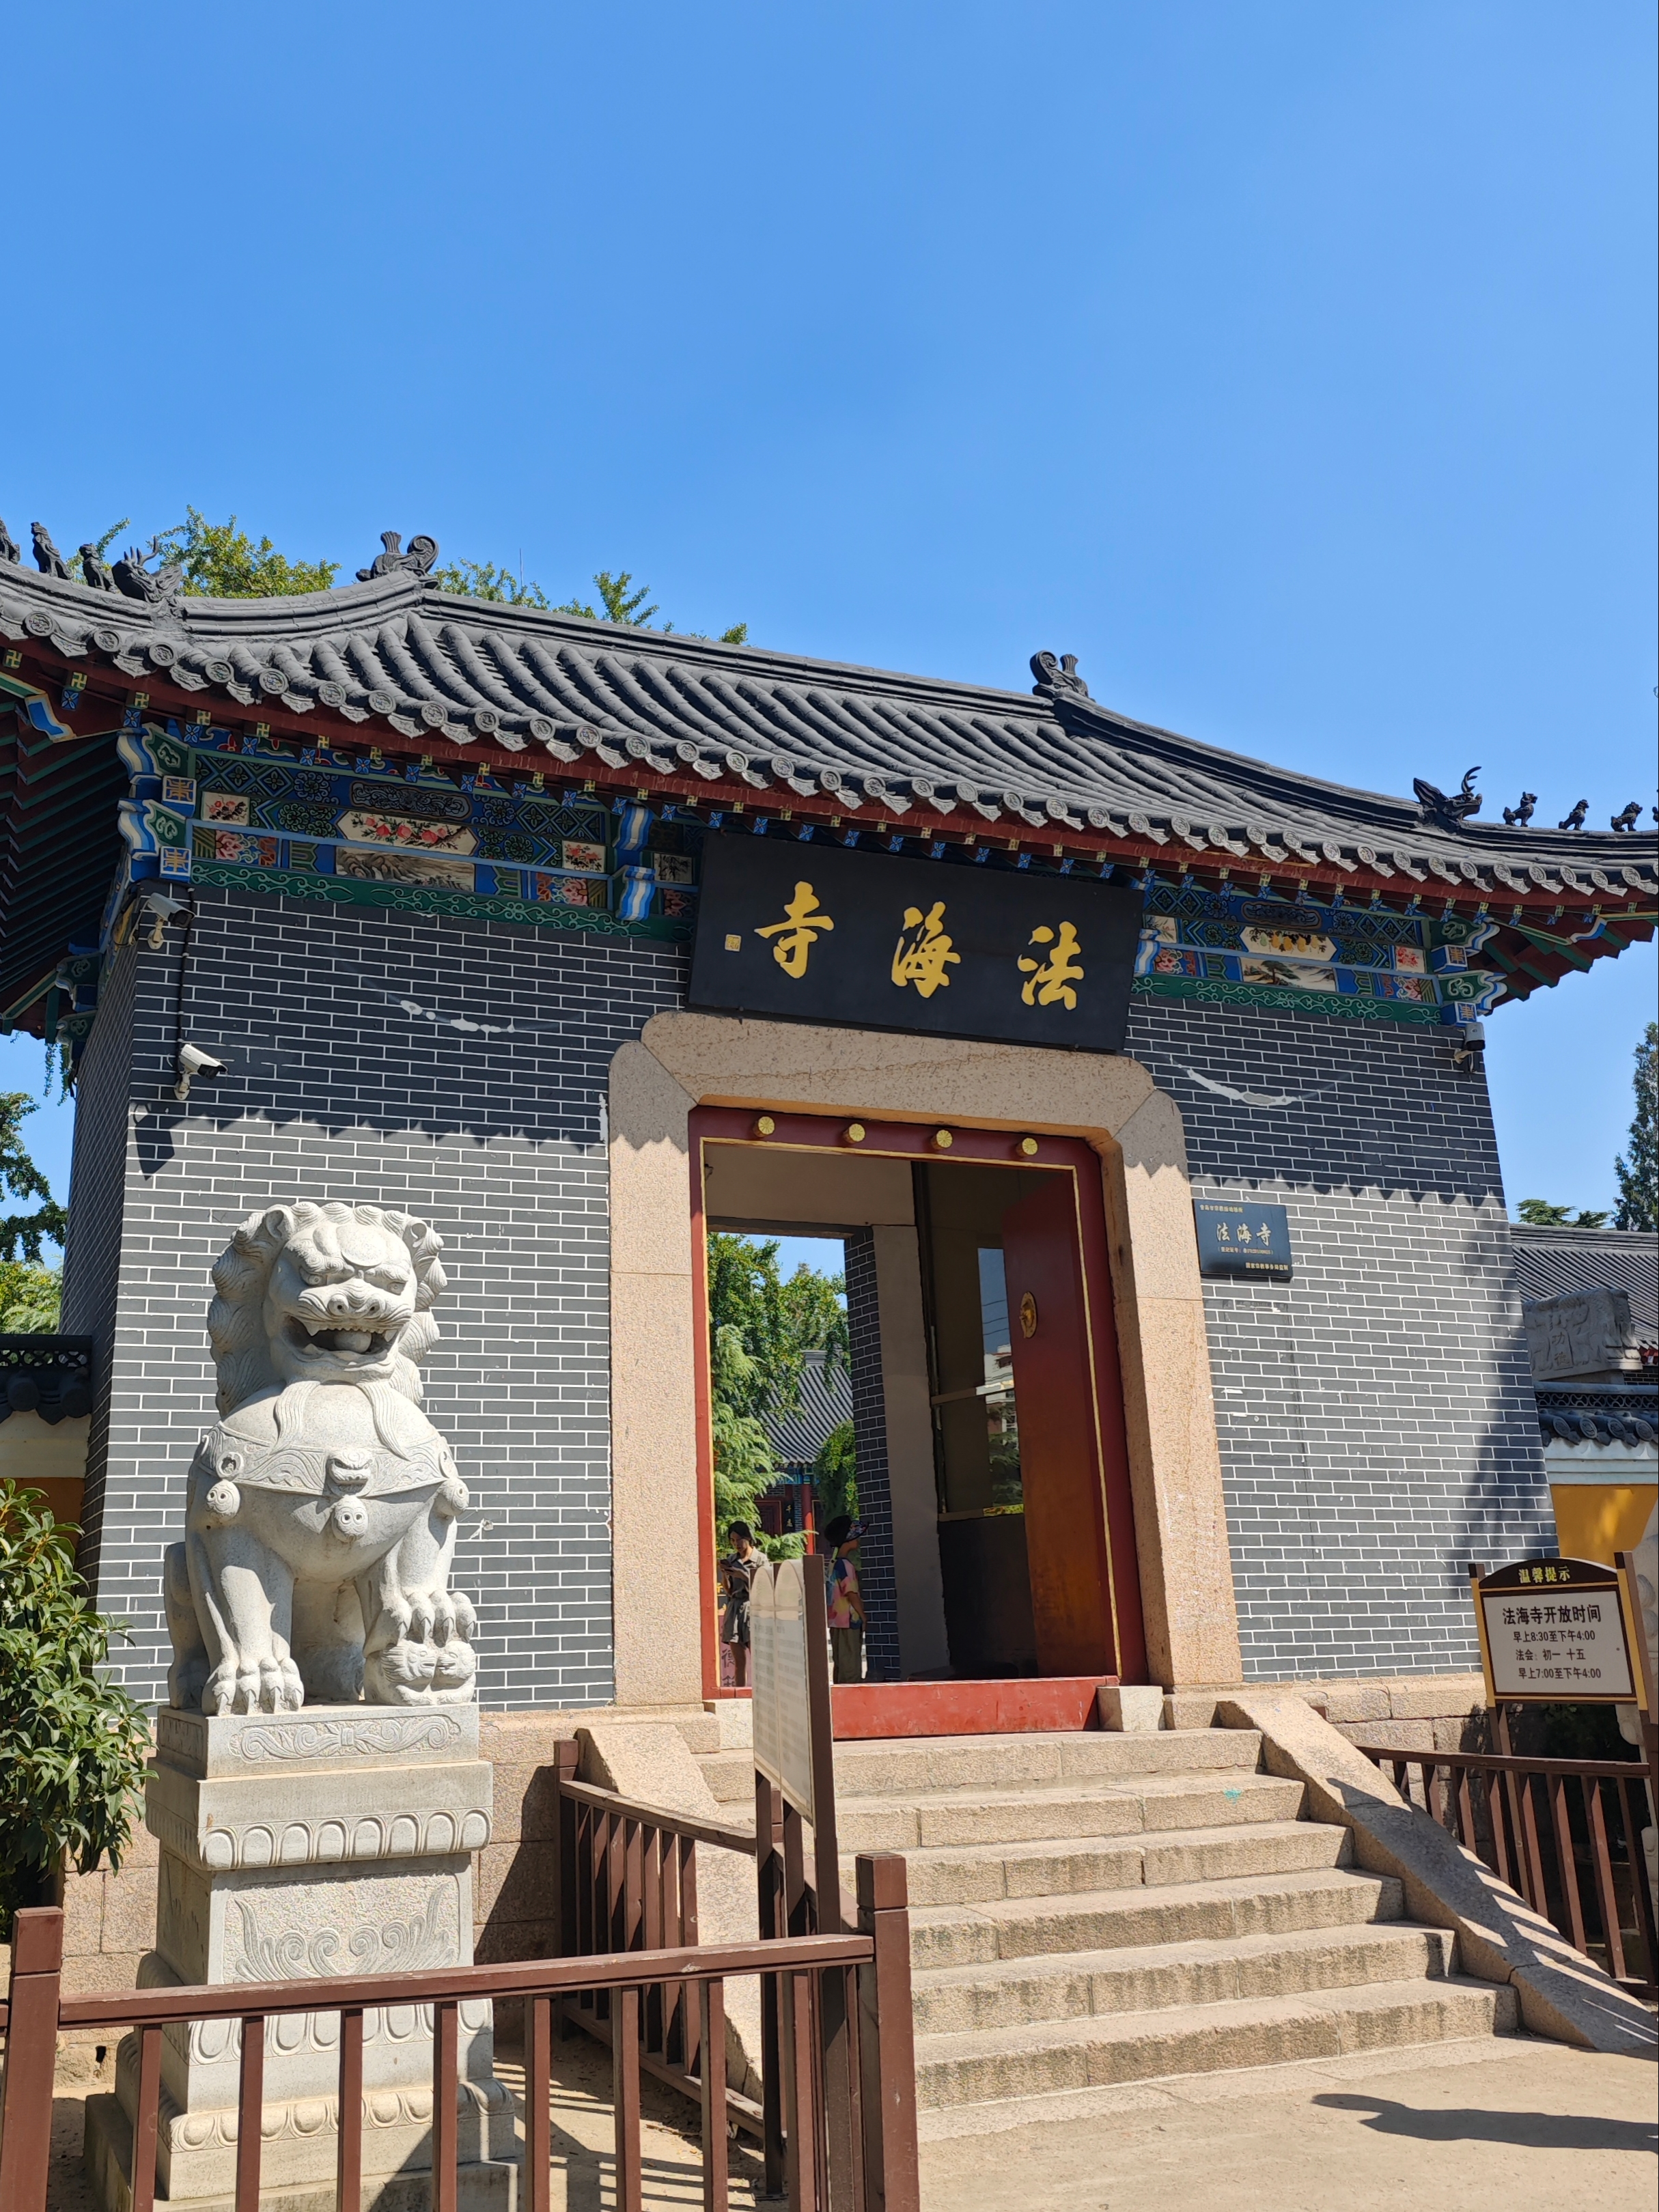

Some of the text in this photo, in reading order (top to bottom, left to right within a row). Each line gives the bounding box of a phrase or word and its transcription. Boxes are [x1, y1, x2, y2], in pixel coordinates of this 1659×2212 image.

[753, 880, 1085, 1011] 法海寺
[1216, 1222, 1272, 1246] 法海寺
[1552, 1332, 1570, 1365] 功德
[1518, 1565, 1570, 1584] 温馨提示
[1502, 1604, 1602, 1625] 法海寺开放时间
[1513, 1629, 1595, 1643] 早上8:30至下午4:00
[1566, 1648, 1587, 1661] 十五
[1518, 1667, 1602, 1680] 早上7:00至下午4:00
